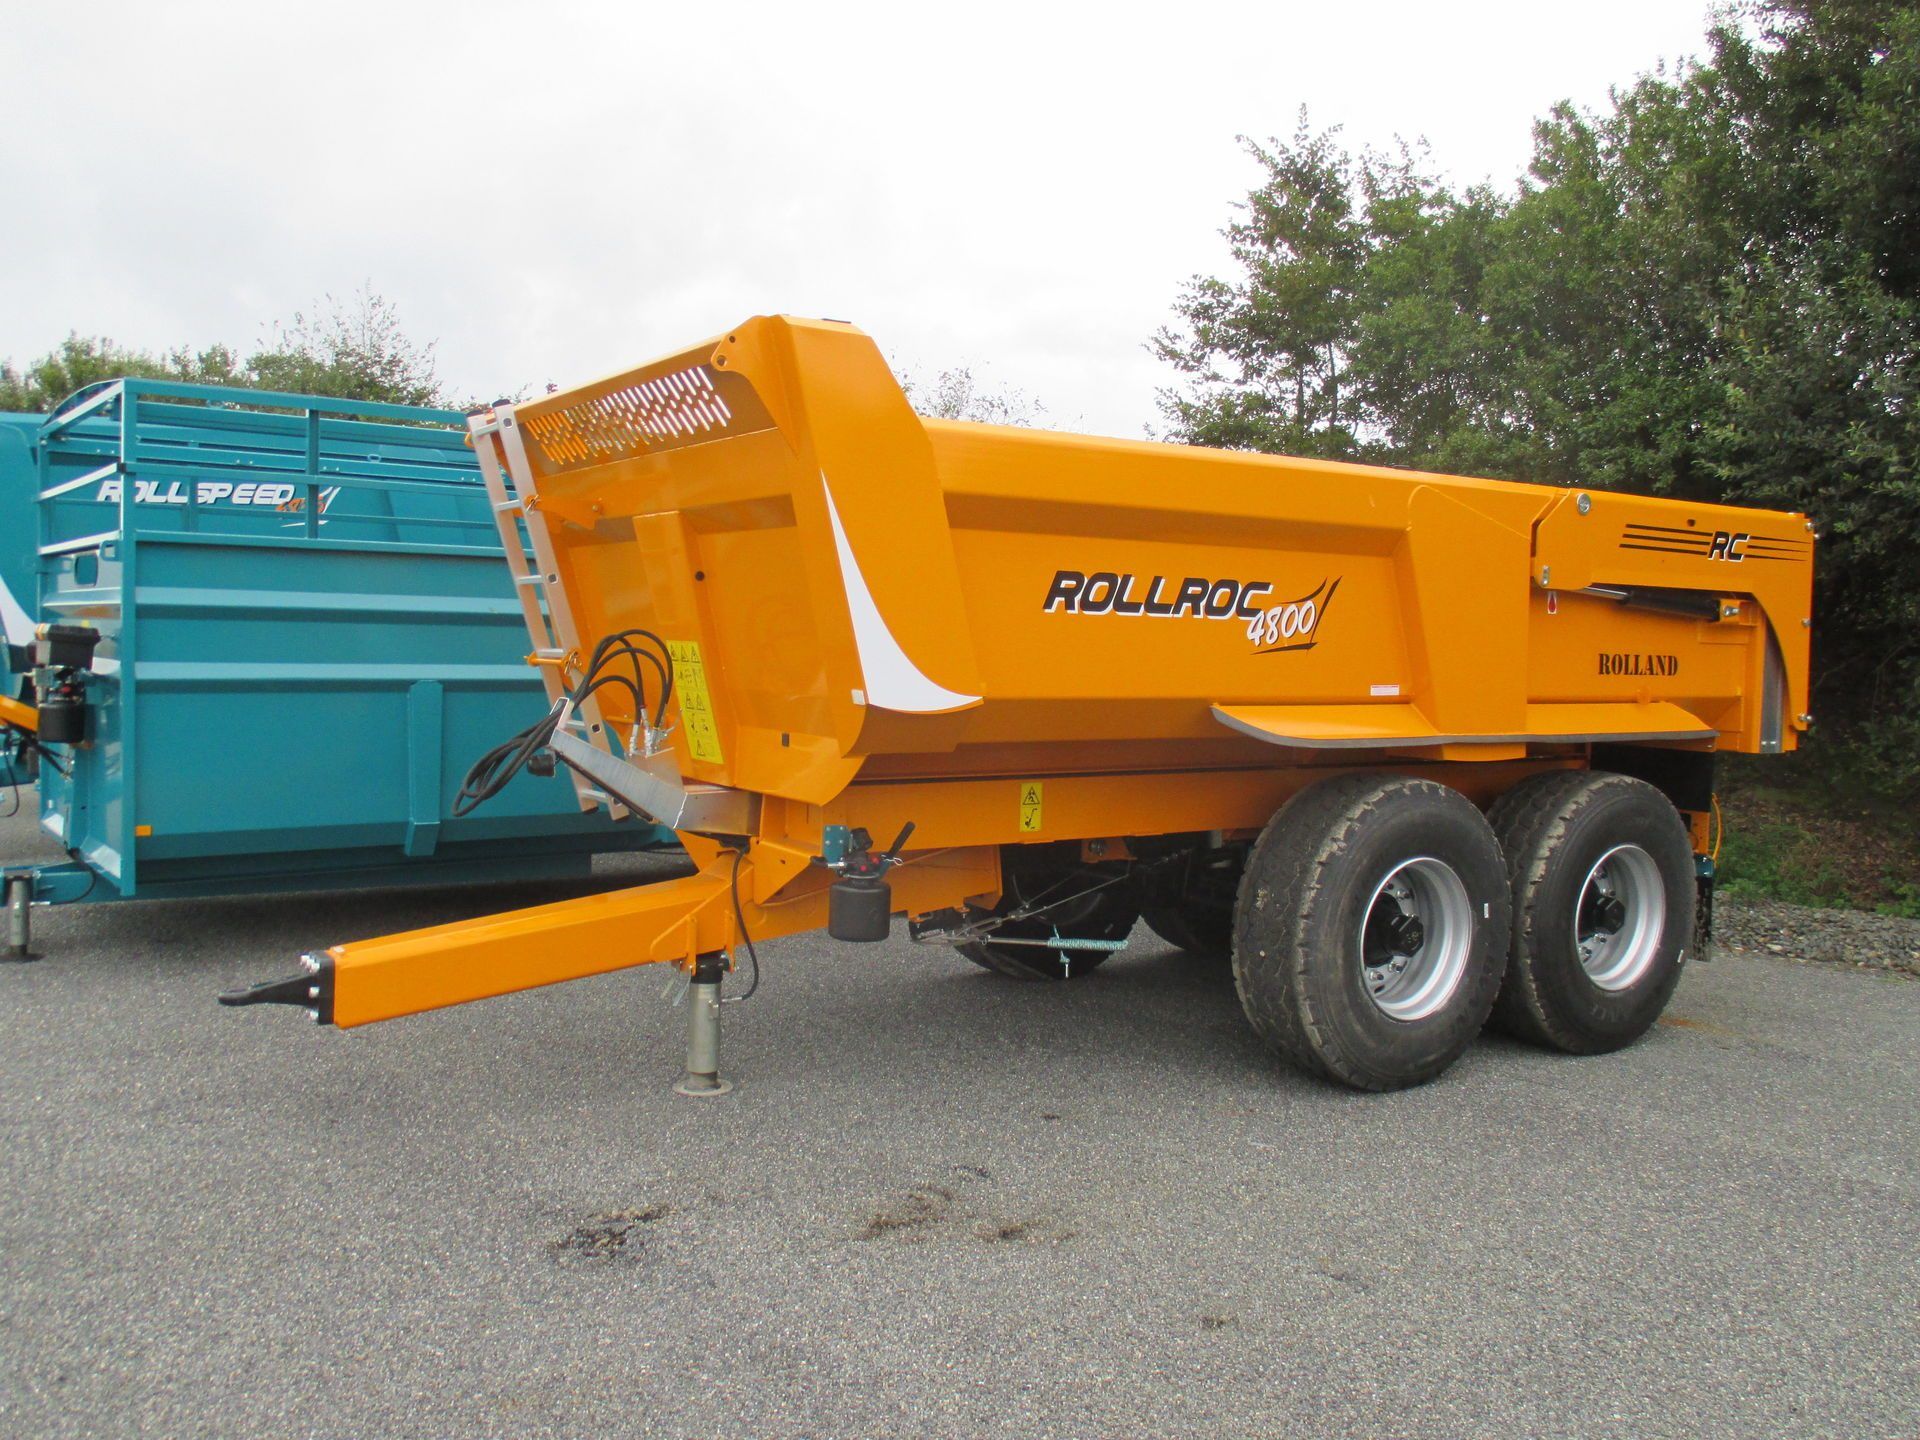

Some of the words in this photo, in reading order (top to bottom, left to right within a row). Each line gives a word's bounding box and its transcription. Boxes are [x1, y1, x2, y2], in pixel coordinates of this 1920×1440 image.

[1707, 531, 1750, 562] RC
[1042, 570, 1273, 620] ROLLROC
[1246, 600, 1316, 646] 4800
[1598, 653, 1678, 676] ROLLAND
